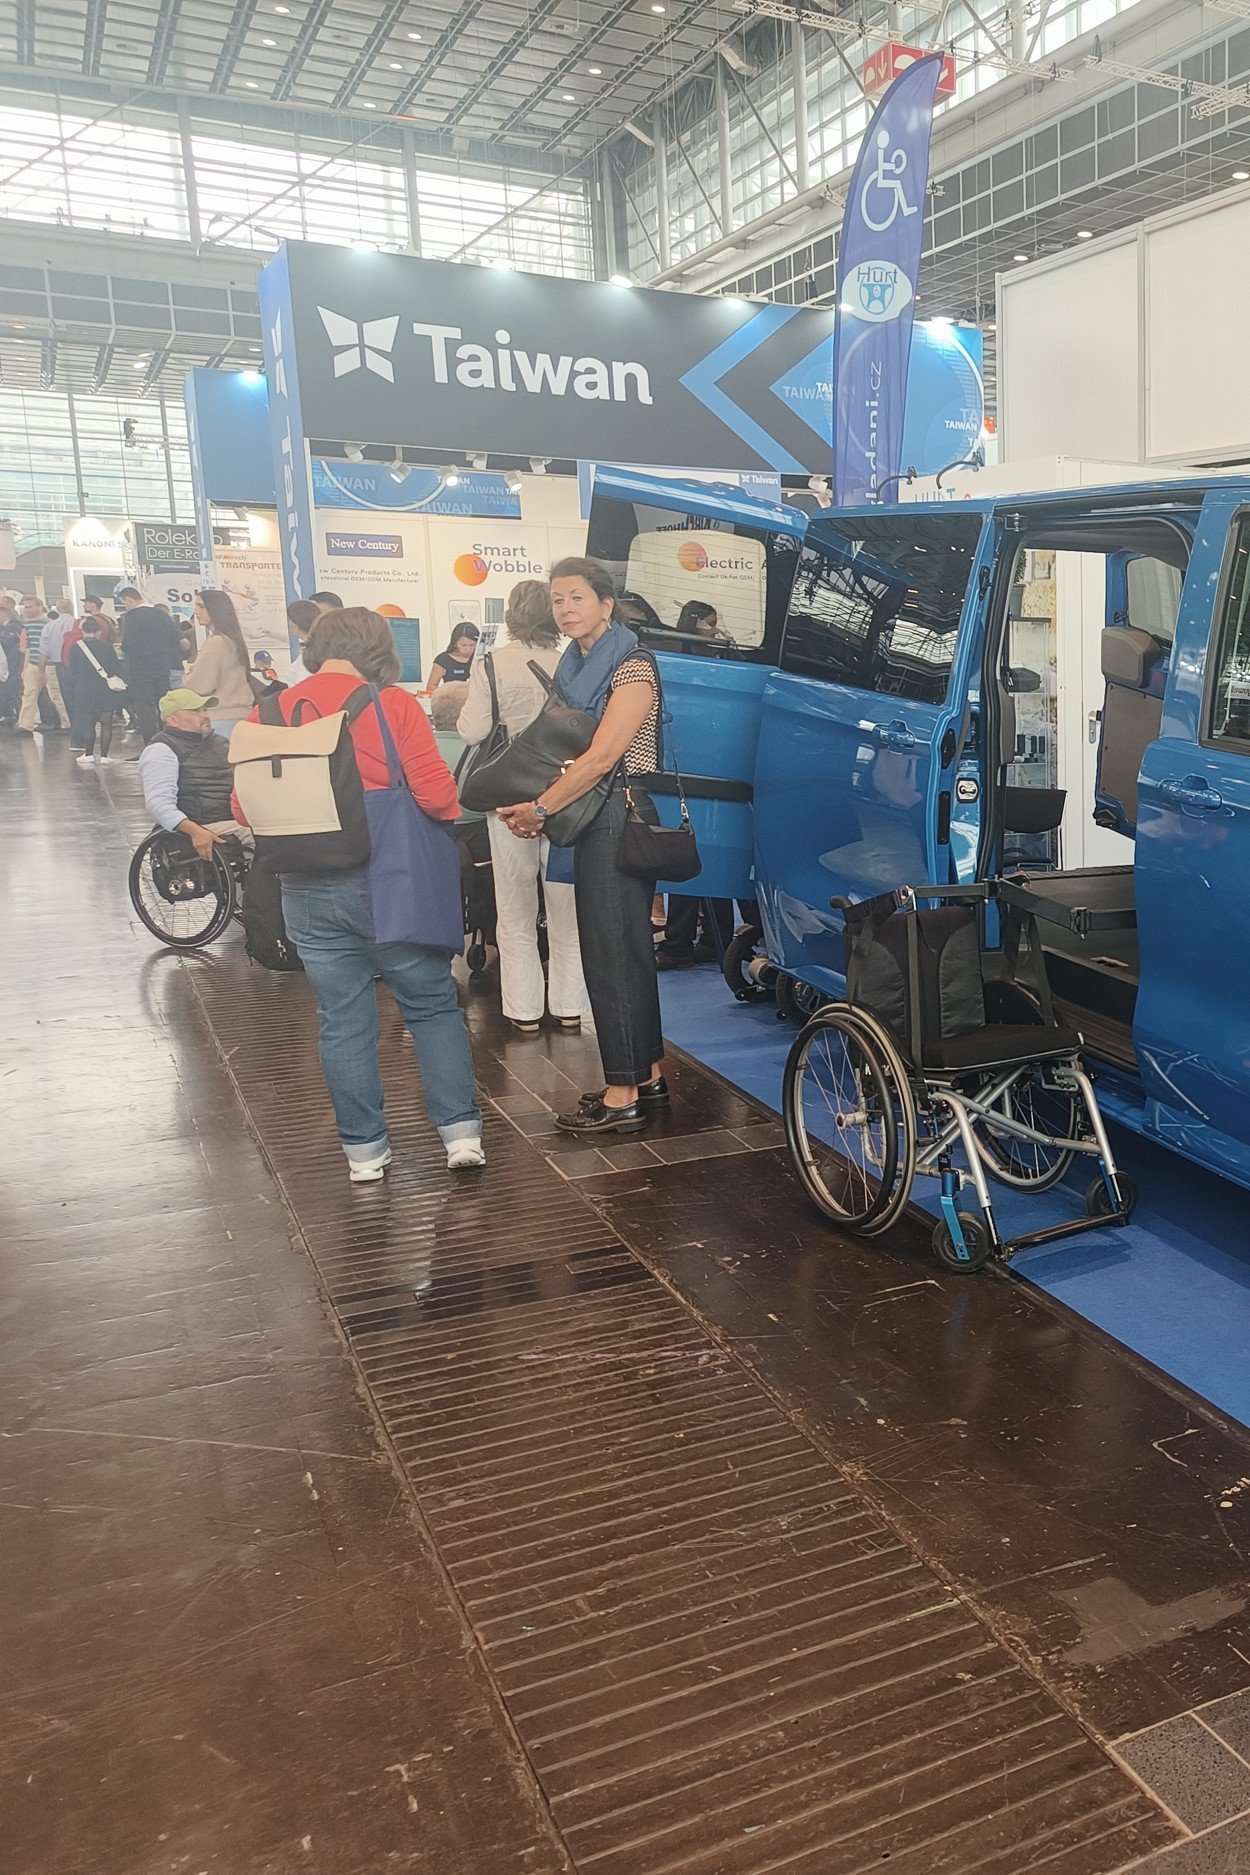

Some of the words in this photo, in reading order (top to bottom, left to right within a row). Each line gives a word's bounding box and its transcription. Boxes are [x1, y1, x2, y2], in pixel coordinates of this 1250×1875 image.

[856, 266, 898, 284] Hurt
[412, 322, 653, 405] Taiwan
[944, 420, 978, 431] TAIWAN
[750, 473, 779, 485] Taiwan
[463, 485, 504, 495] TAIWAN
[72, 540, 115, 548] KANGNI
[330, 538, 355, 549] New
[358, 539, 400, 553] Century
[472, 543, 527, 558] Smart
[148, 547, 171, 559] Der
[473, 560, 542, 574] Wobble
[695, 556, 753, 570] Electric
